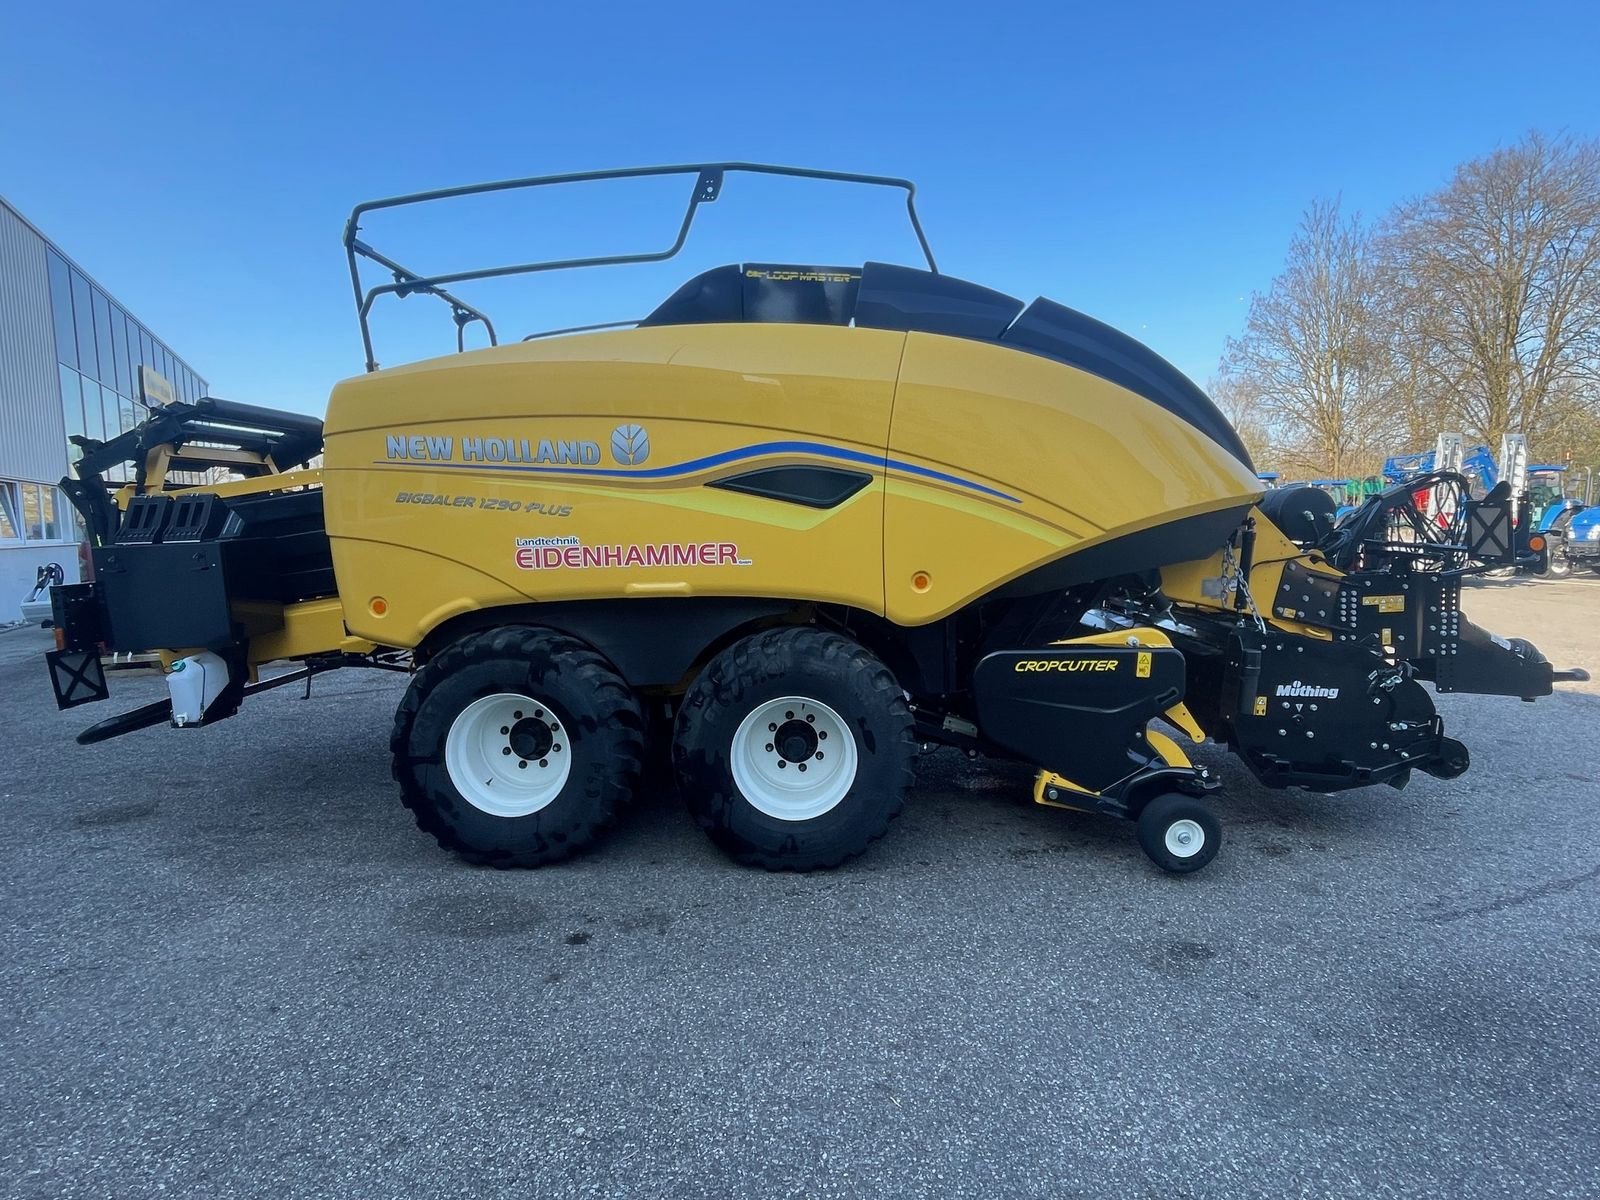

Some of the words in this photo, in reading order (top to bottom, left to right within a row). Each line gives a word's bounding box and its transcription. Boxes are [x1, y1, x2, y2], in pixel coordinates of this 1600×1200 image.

[386, 435, 453, 460] NEW
[462, 437, 600, 465] HOLLAND
[479, 497, 522, 512] 1290
[516, 537, 579, 546] Landtechnik
[516, 543, 737, 569] EIDENHAMMER
[1014, 659, 1119, 673] CROPCUTTER
[1276, 680, 1340, 699] Müthing
